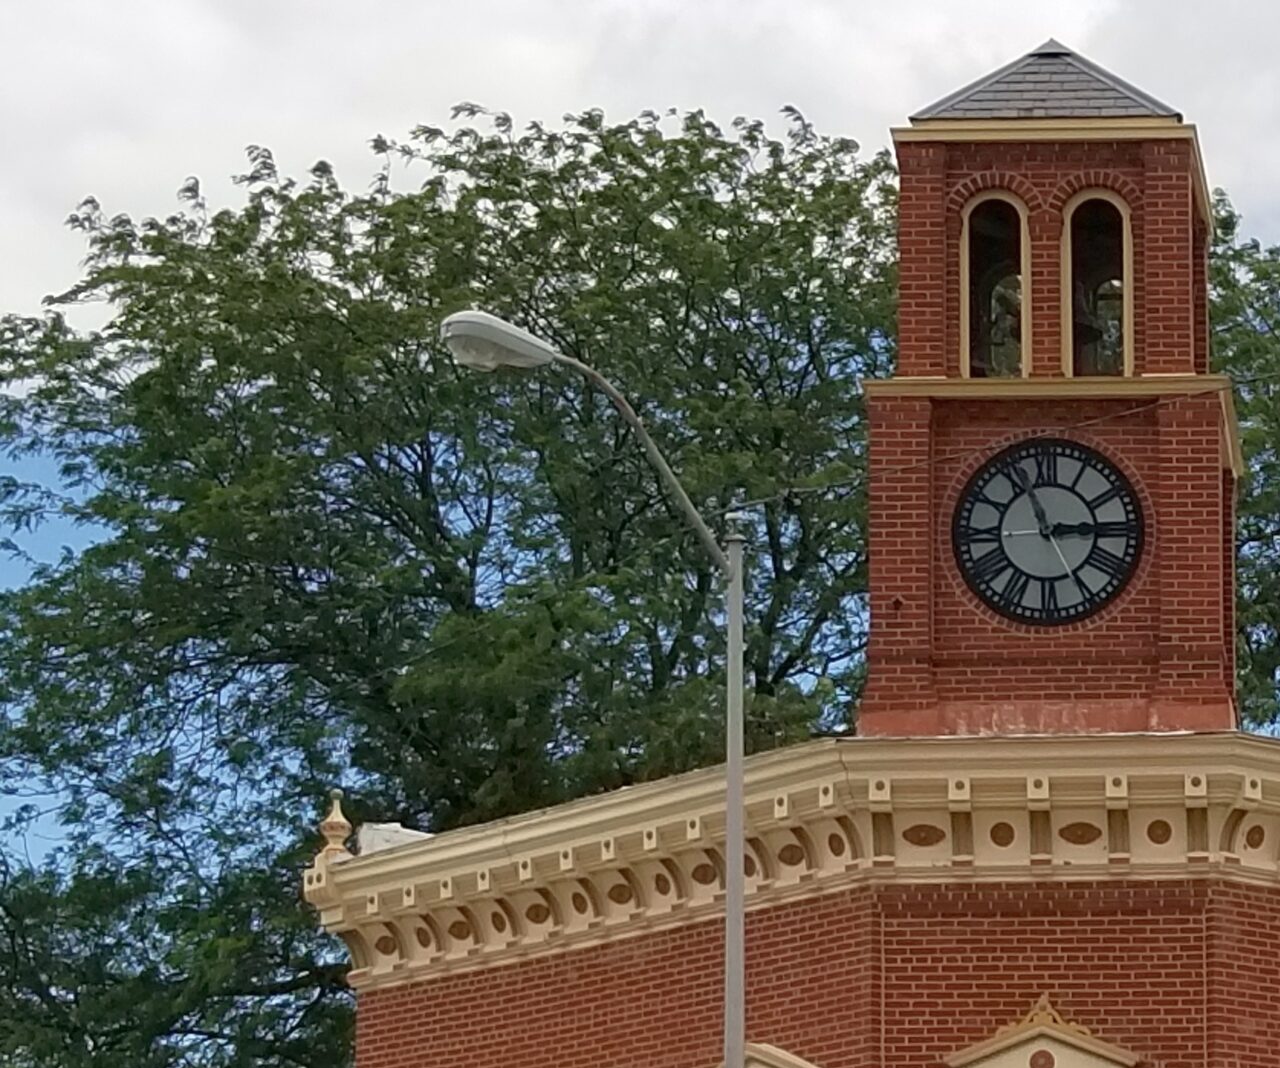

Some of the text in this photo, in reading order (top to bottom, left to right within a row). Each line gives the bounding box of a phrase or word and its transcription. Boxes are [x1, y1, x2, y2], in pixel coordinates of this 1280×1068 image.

[1034, 455, 1058, 485] XII
[1071, 461, 1088, 490] I
[974, 490, 1009, 512] X
[1088, 487, 1120, 510] II
[1095, 521, 1128, 538] III
[1001, 569, 1029, 604] VII
[1040, 580, 1059, 610] VI
